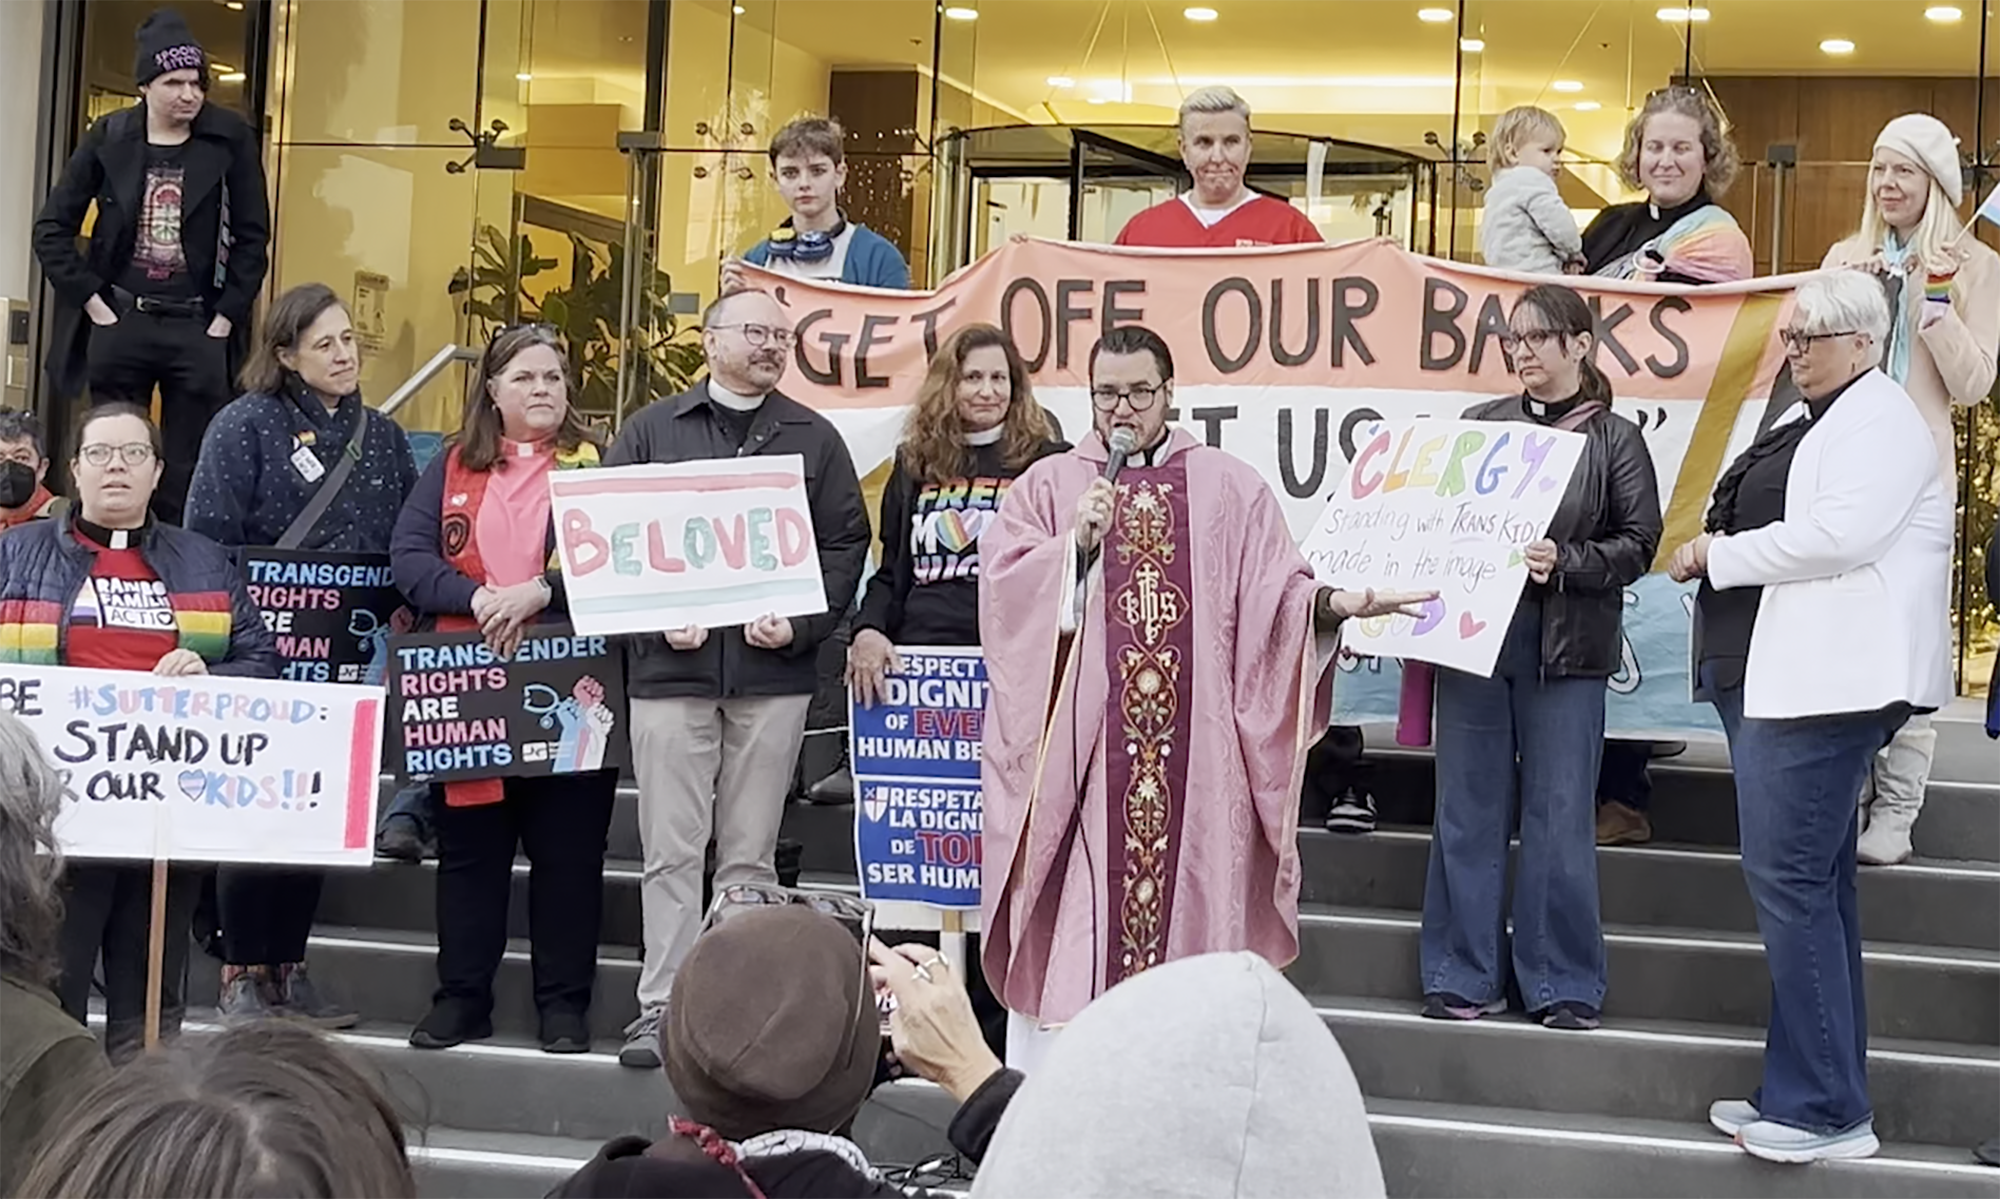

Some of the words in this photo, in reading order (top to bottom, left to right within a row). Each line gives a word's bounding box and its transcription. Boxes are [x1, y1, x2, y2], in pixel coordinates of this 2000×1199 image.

[1001, 277, 1147, 374] OFF
[1202, 276, 1380, 375] OUR
[1420, 276, 1693, 378] BAKS
[1352, 425, 1557, 500] CLERGY
[1325, 502, 1410, 541] Standing
[1417, 508, 1444, 532] with
[1450, 501, 1497, 536] TRANS
[562, 507, 811, 577] BELOVED
[1308, 540, 1372, 575] made
[1384, 553, 1399, 577] in
[1413, 546, 1437, 579] the
[1443, 550, 1496, 594] image
[246, 585, 340, 610] RIGHTS
[398, 636, 607, 671] TRANSENDER
[884, 657, 979, 677] ESPECT
[400, 667, 507, 696] RIGHTS
[69, 683, 329, 724] #SUTTERPROUD:
[402, 696, 459, 722] ARE
[404, 718, 507, 747] HUMAN
[885, 714, 909, 730] OF
[914, 708, 984, 740] EVE
[54, 720, 209, 764] STAND
[220, 733, 269, 765] UP
[406, 743, 513, 772] RIGHTS
[858, 737, 951, 760] HUMAN
[955, 741, 982, 761] BE
[86, 770, 165, 801] OUR
[205, 770, 321, 811] KIDS!!!
[889, 808, 916, 828] LA
[891, 839, 915, 854] DE
[867, 863, 916, 884] SER
[920, 864, 981, 889] HUM
